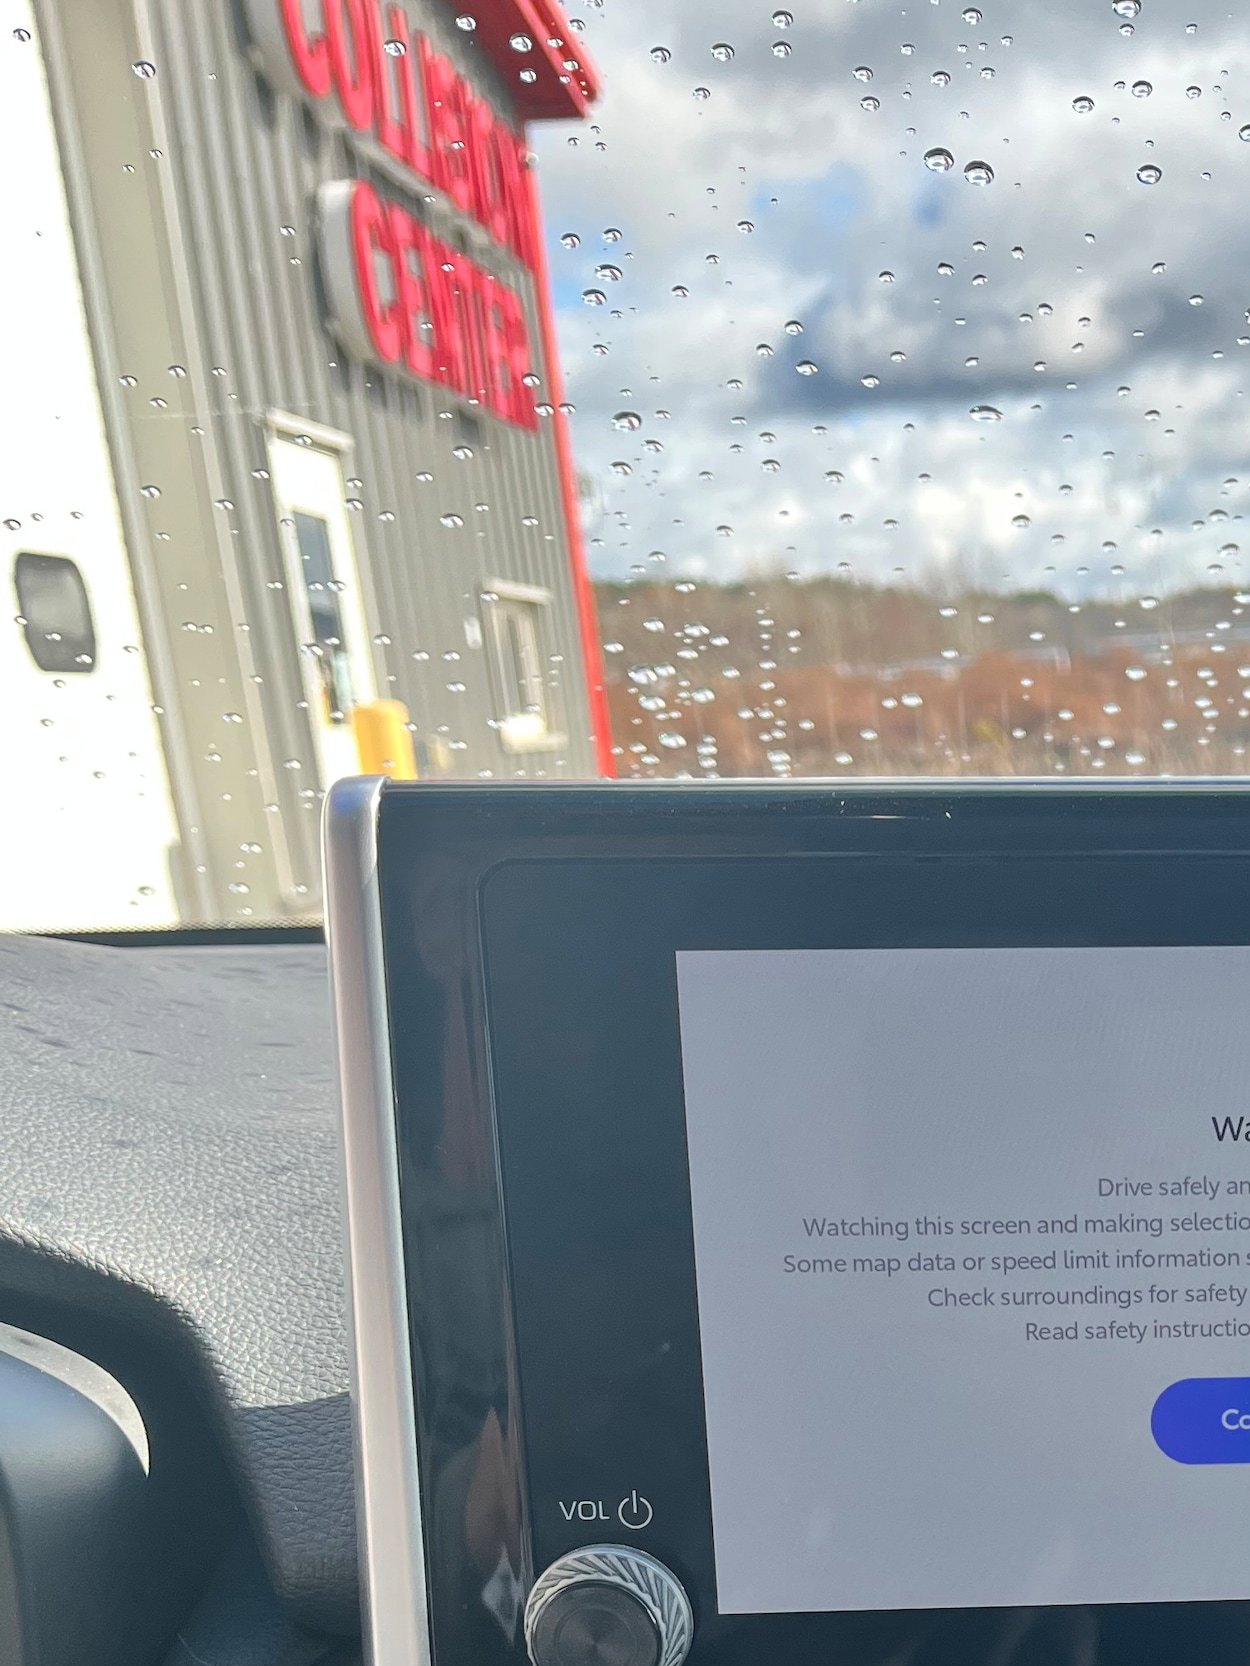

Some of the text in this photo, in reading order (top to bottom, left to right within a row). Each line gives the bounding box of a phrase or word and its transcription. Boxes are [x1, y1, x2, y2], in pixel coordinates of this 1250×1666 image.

[351, 179, 538, 433] CENTER
[1098, 1176, 1153, 1197] Drive
[1158, 1175, 1221, 1201] safely
[802, 1216, 909, 1242] Watching
[914, 1215, 954, 1236] this
[960, 1219, 1032, 1236] screen
[1037, 1213, 1078, 1234] and
[1084, 1212, 1163, 1238] making
[783, 1254, 848, 1273] Some
[852, 1257, 902, 1278] map
[907, 1251, 956, 1272] data
[962, 1256, 986, 1271] or
[991, 1249, 1057, 1276] speed
[1063, 1249, 1111, 1270] limit
[1116, 1247, 1241, 1269] information
[927, 1286, 996, 1307] Check
[1000, 1284, 1143, 1310] surroundings
[1148, 1284, 1179, 1304] for
[1184, 1282, 1248, 1308] safety
[1025, 1320, 1079, 1341] Read
[1084, 1319, 1148, 1345] safety
[558, 1500, 610, 1521] VOL
